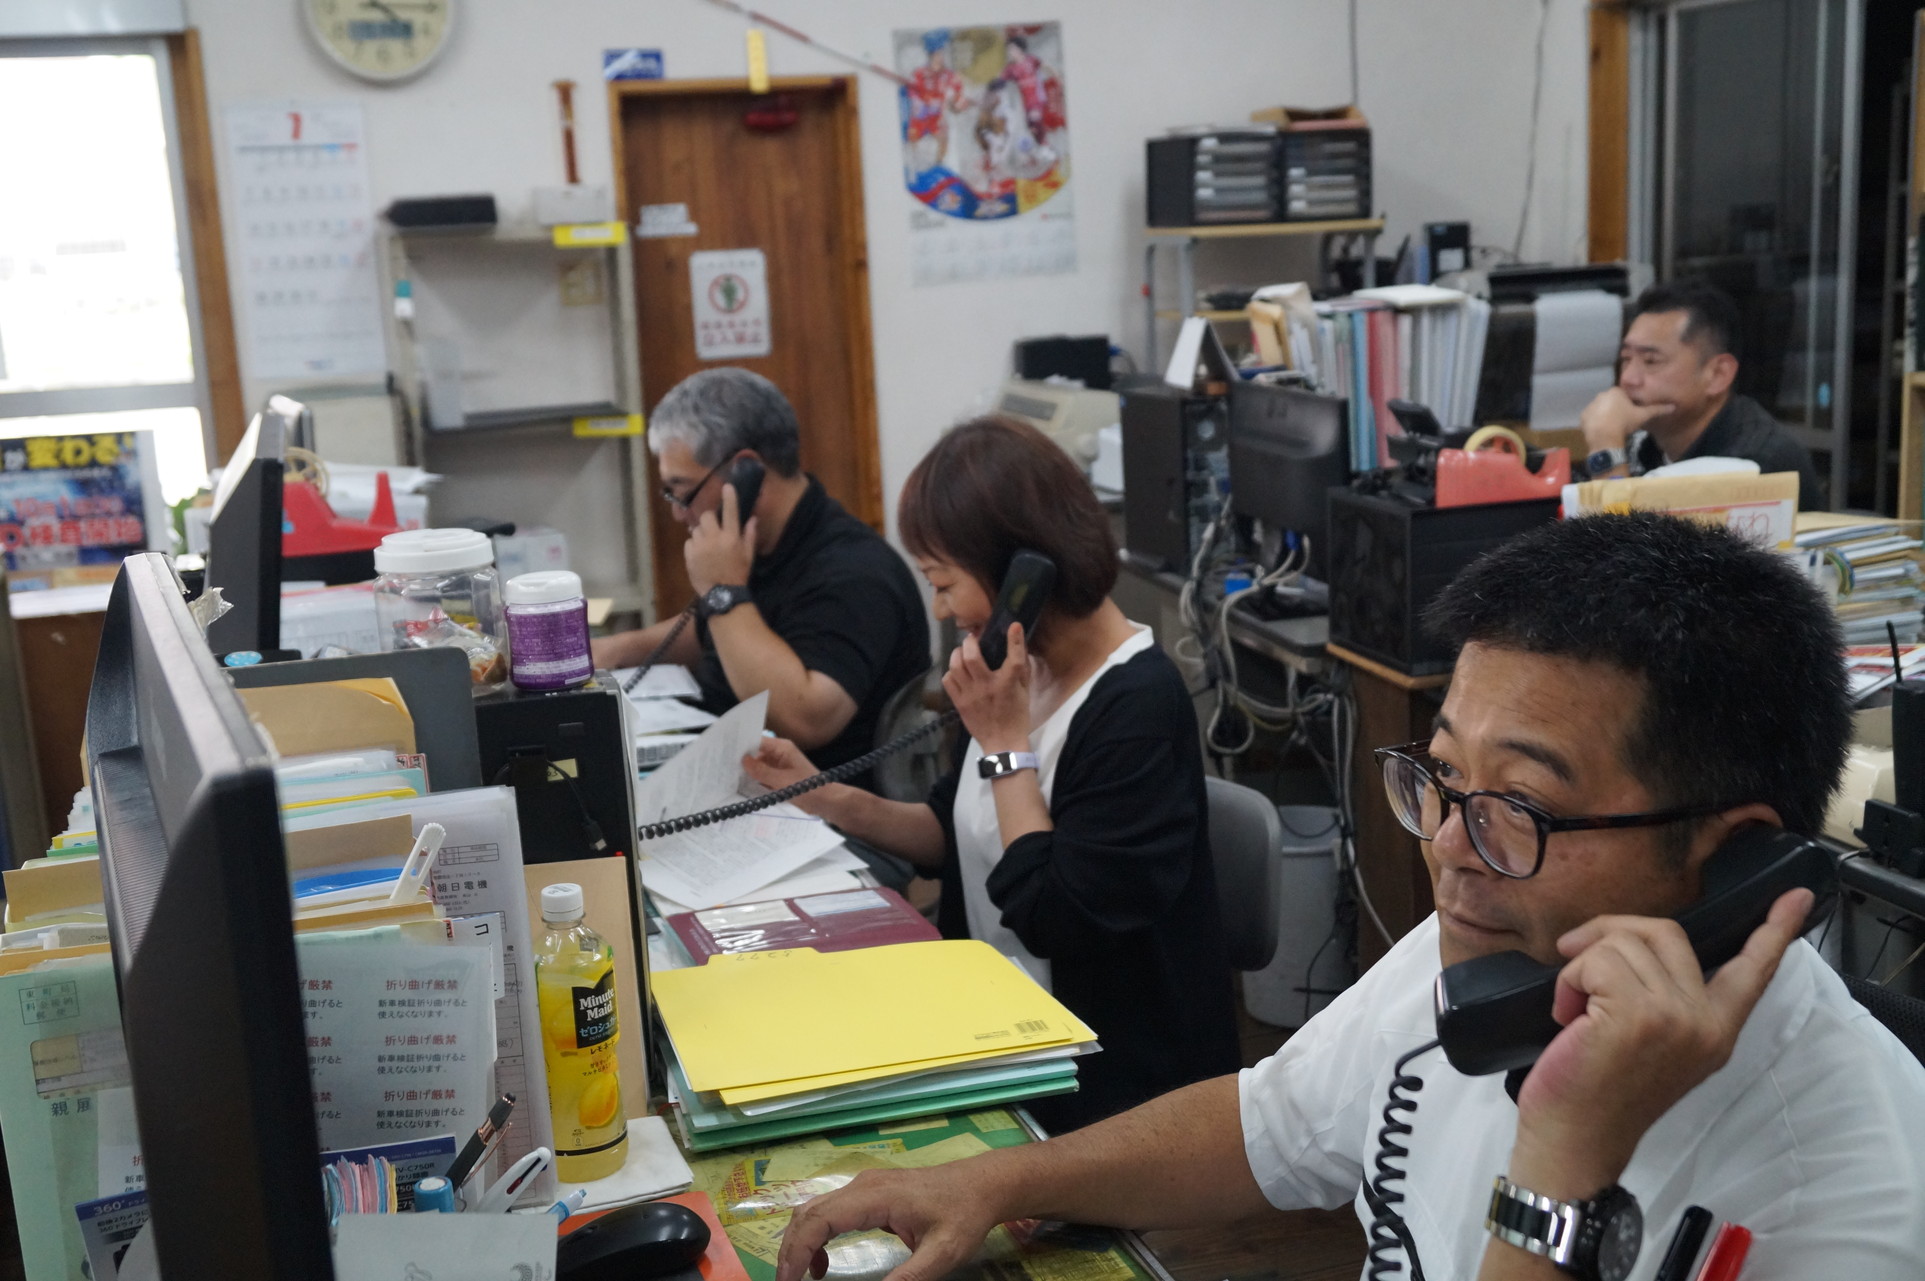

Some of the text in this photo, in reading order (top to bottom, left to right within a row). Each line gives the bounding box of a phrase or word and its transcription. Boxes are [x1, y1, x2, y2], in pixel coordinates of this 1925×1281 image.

[437, 880, 487, 893] 朝日電機
[386, 979, 458, 991] 折り曲げ厳禁
[378, 999, 467, 1008] 新車検証折り曲げると
[579, 987, 615, 1011] Minute
[377, 1010, 448, 1019] 使えなくなります。
[586, 1000, 613, 1022] Maid
[385, 1034, 457, 1046] 折り曲げ厳禁
[377, 1054, 466, 1063] 新車検証折り曲げると
[377, 1065, 447, 1074] 使えなくなります。
[384, 1089, 456, 1102] 折り曲げ厳禁
[51, 1097, 91, 1117] 親展
[376, 1108, 465, 1118] 新車検証折り曲げると
[376, 1120, 446, 1130] 使えなくなります。
